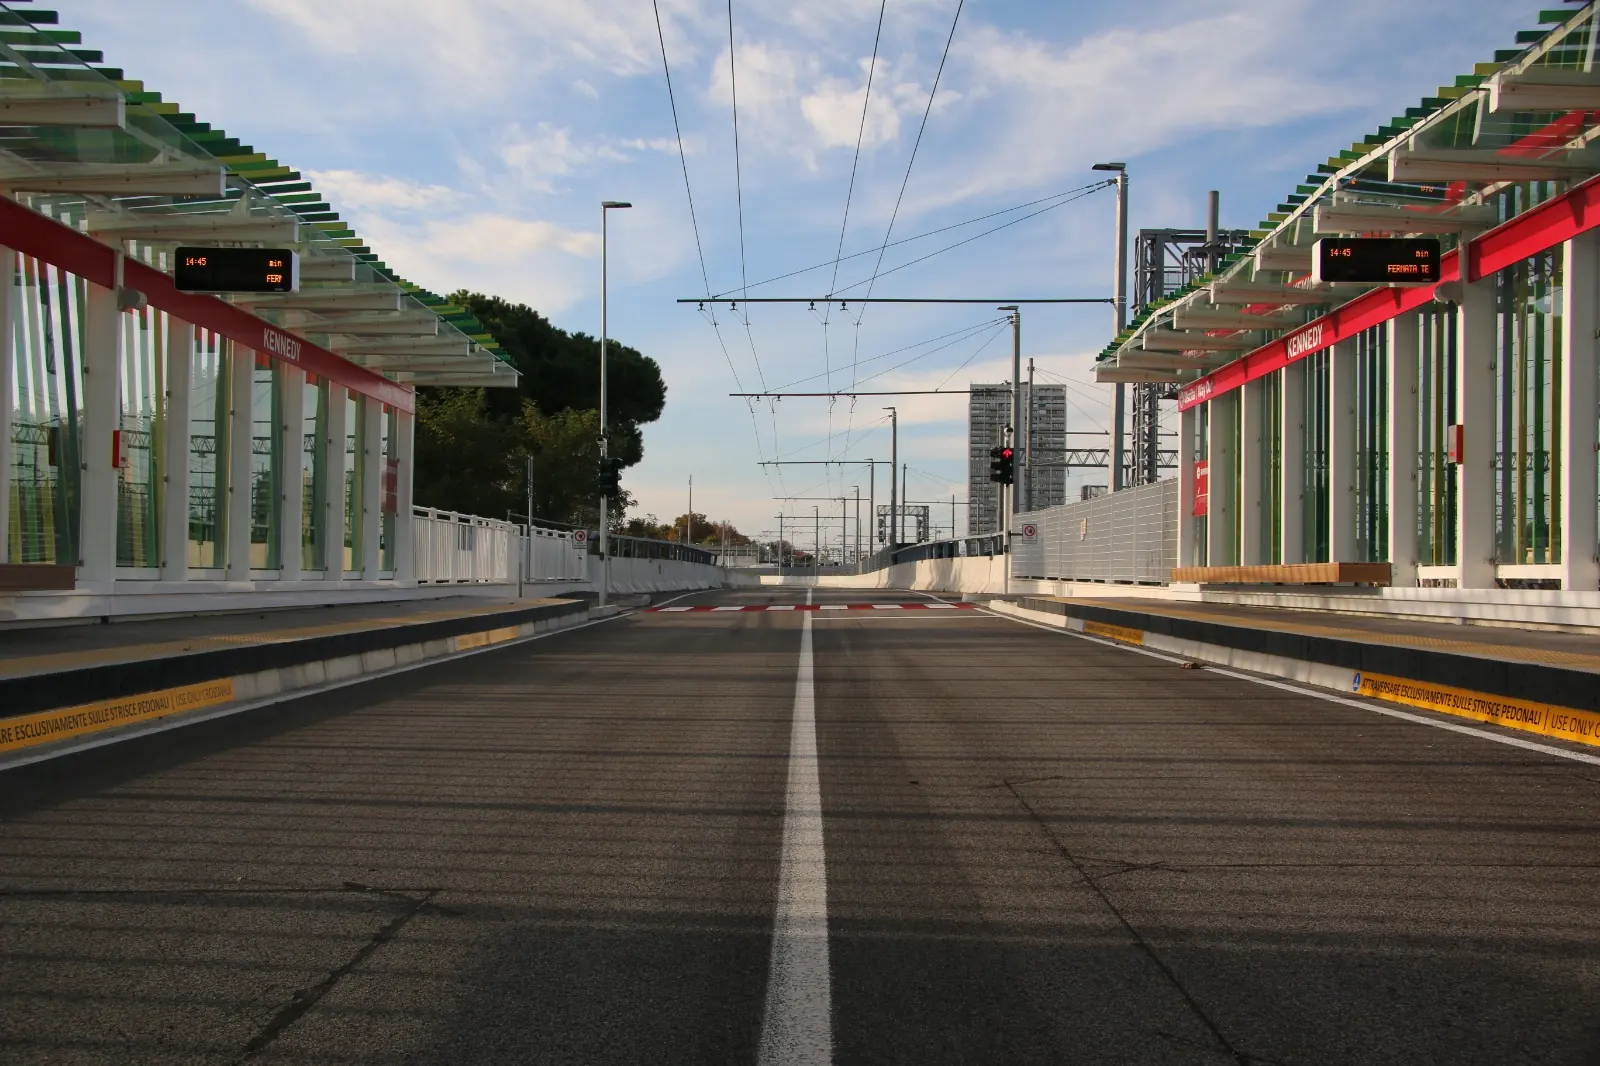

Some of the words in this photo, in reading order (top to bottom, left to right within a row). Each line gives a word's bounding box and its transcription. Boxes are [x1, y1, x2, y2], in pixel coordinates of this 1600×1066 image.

[185, 257, 207, 266] 14:45
[1330, 248, 1351, 257] 14:45
[1387, 264, 1418, 273] FERMATA
[1420, 265, 1430, 273] TE
[263, 328, 301, 362] KENNEDY
[1287, 324, 1323, 359] KENNEDY
[0, 728, 13, 744] RE
[16, 714, 87, 741] ESCLUSIVAMENTE
[89, 708, 110, 726] SULLE
[110, 703, 137, 720] STRISCE
[138, 698, 169, 716] PEDONALI
[1362, 678, 1400, 696] ATTRAVERSARE
[1400, 685, 1451, 706] ESCLUSIVAMENTE
[1452, 695, 1472, 712] SULLE
[1473, 699, 1500, 717] STRISCE
[1501, 704, 1541, 725] PEDONALI
[1551, 713, 1568, 730] USE
[1569, 717, 1594, 736] ONLY
